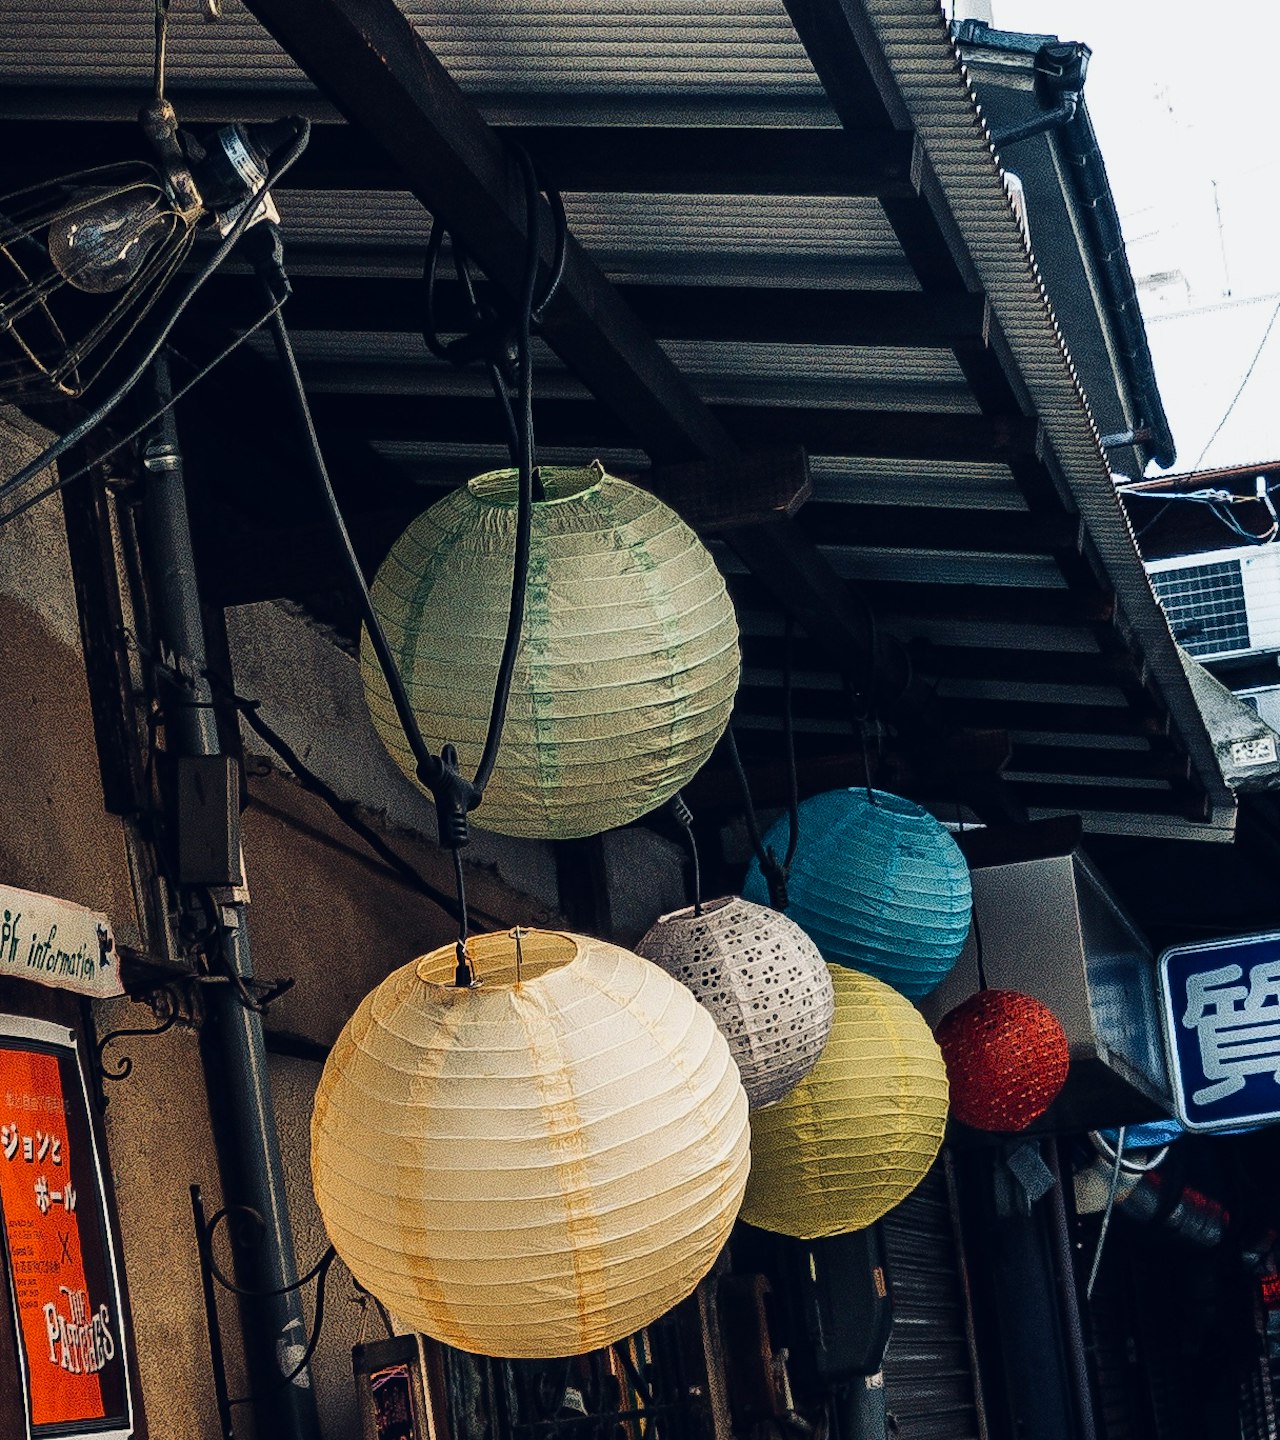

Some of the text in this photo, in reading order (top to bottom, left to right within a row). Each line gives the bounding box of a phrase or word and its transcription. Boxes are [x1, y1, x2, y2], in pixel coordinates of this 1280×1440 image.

[27, 924, 96, 980] information
[0, 1122, 62, 1163] ジョンと
[59, 1285, 87, 1326] THE
[42, 1293, 115, 1375] PATCHES
